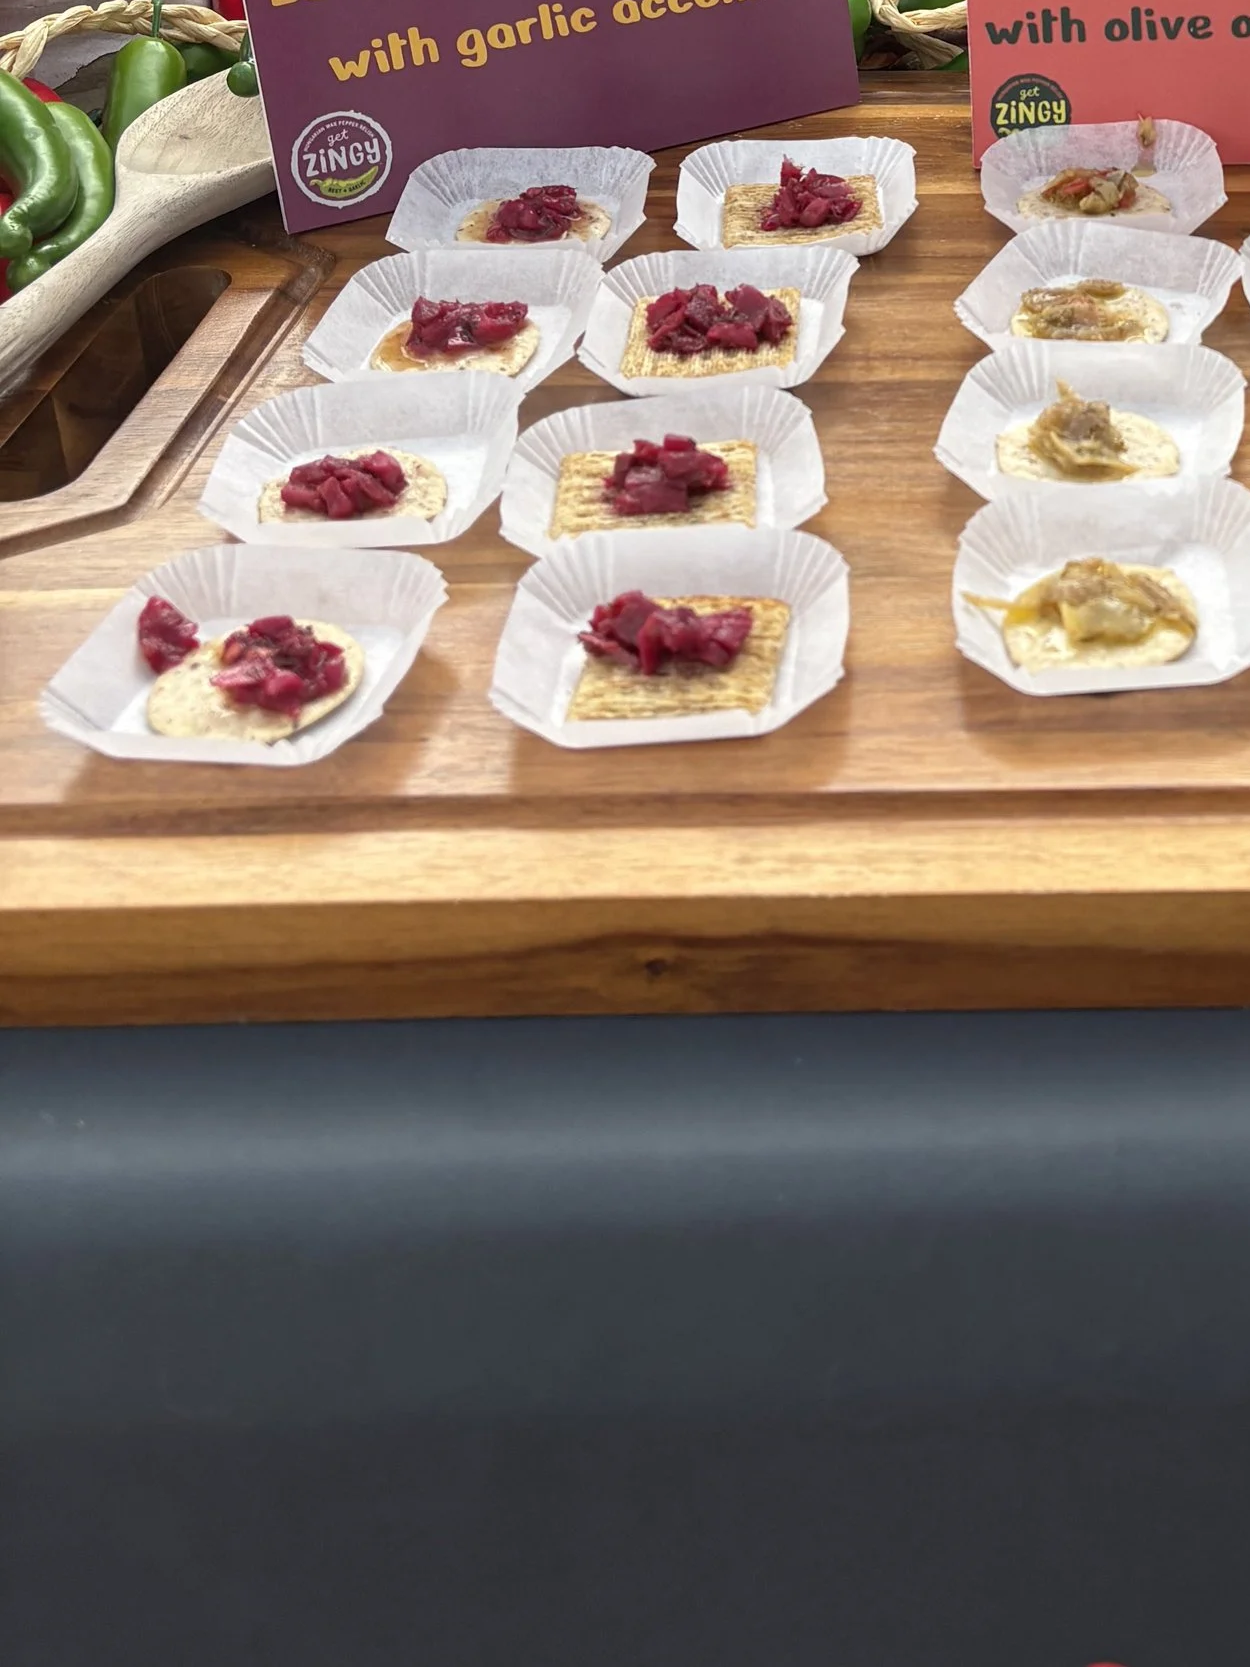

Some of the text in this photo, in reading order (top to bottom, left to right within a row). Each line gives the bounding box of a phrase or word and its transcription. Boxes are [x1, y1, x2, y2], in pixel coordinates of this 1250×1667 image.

[984, 6, 1088, 47] with
[1103, 5, 1215, 43] olive
[327, 26, 441, 82] with
[455, 3, 599, 69] garlic
[1019, 85, 1041, 100] get
[327, 128, 349, 147] get
